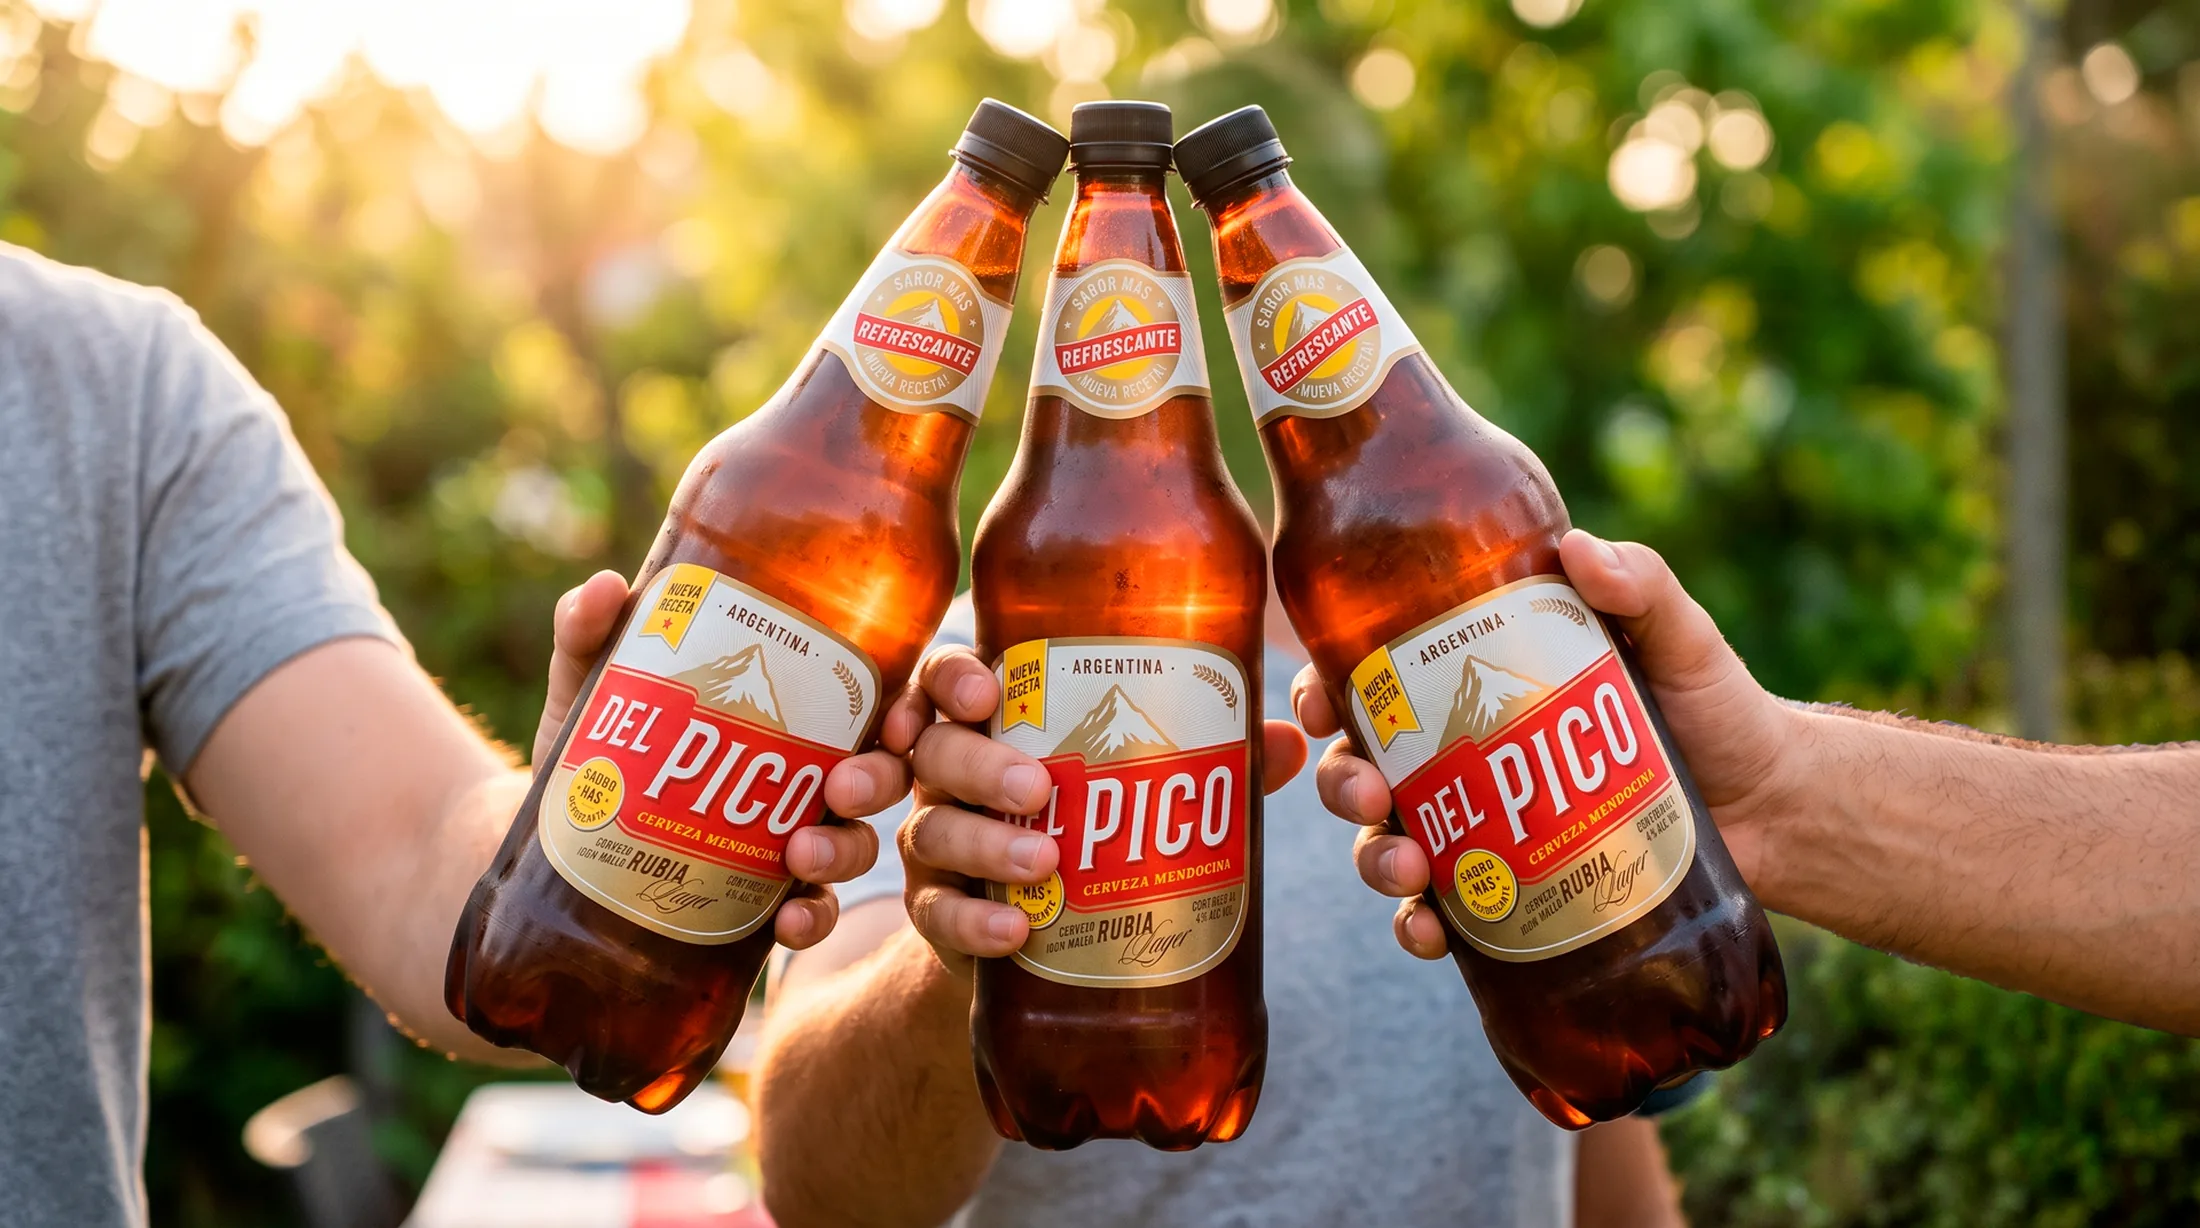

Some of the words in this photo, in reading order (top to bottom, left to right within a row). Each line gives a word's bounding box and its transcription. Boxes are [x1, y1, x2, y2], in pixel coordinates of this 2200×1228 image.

[945, 281, 973, 312] MAS
[1072, 276, 1116, 311] SABOR
[857, 321, 975, 368] REFRESCANTE
[1062, 329, 1177, 369] REFRESCANTE
[1270, 303, 1372, 388] REFRESCANTE
[658, 598, 695, 614] RECETA
[667, 583, 702, 599] NUEVA
[726, 604, 811, 657] ARGENTINA
[1419, 612, 1506, 666] ARGENTINA
[1009, 658, 1040, 683] NUEVA
[1072, 659, 1163, 675] ARGENTINA
[1363, 667, 1394, 701] NUEVA
[1007, 679, 1040, 701] RECETA
[1369, 684, 1401, 719] RECETA
[586, 694, 663, 754] DEL
[643, 717, 823, 835] PICO
[1416, 775, 1486, 857] DEL
[1484, 682, 1638, 846] PICO
[1078, 765, 1233, 871] PICO
[1528, 820, 1588, 865] CERVEZA
[1589, 767, 1656, 826] MENDOCINA
[637, 811, 701, 841] CERVEZA
[704, 833, 781, 863] MENDOCINA
[626, 850, 690, 884] RUBIA
[1083, 877, 1149, 897] CERVEZA
[1154, 858, 1231, 885] MENDOCINA
[1559, 851, 1613, 904] RUBIA
[1592, 849, 1650, 914] Lager
[636, 878, 719, 914] Lager
[1097, 911, 1154, 943] RUBIA
[1118, 918, 1193, 968] Lager
